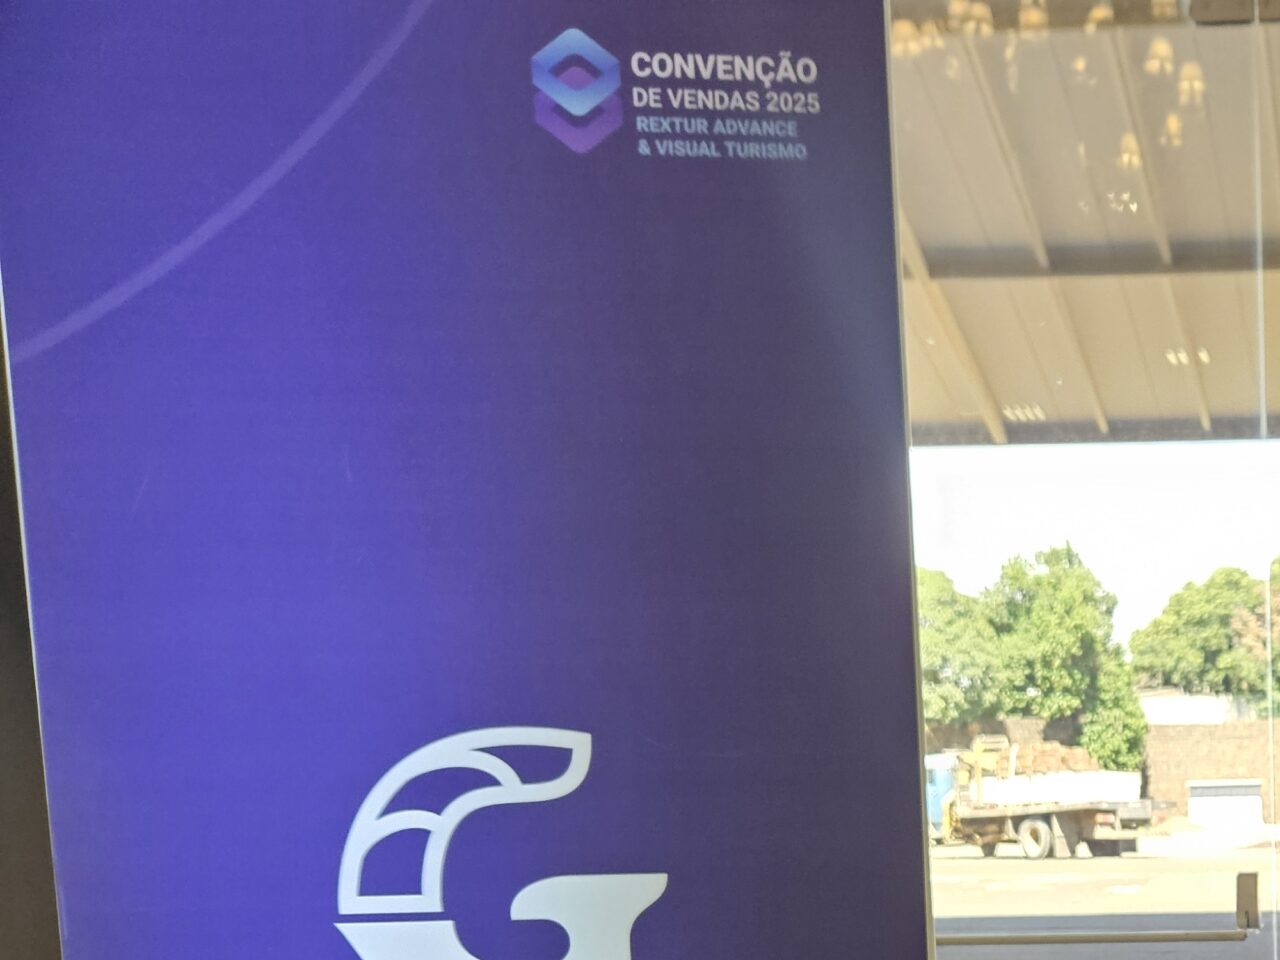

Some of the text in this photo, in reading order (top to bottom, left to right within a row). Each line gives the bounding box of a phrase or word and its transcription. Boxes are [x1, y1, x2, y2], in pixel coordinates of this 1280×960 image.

[631, 50, 818, 88] CONVENÇÃO
[632, 87, 820, 114] DE VENDAS 2025
[636, 116, 798, 138] REXTUR ADVANCE
[638, 140, 808, 160] & VISUAL TURISMO
